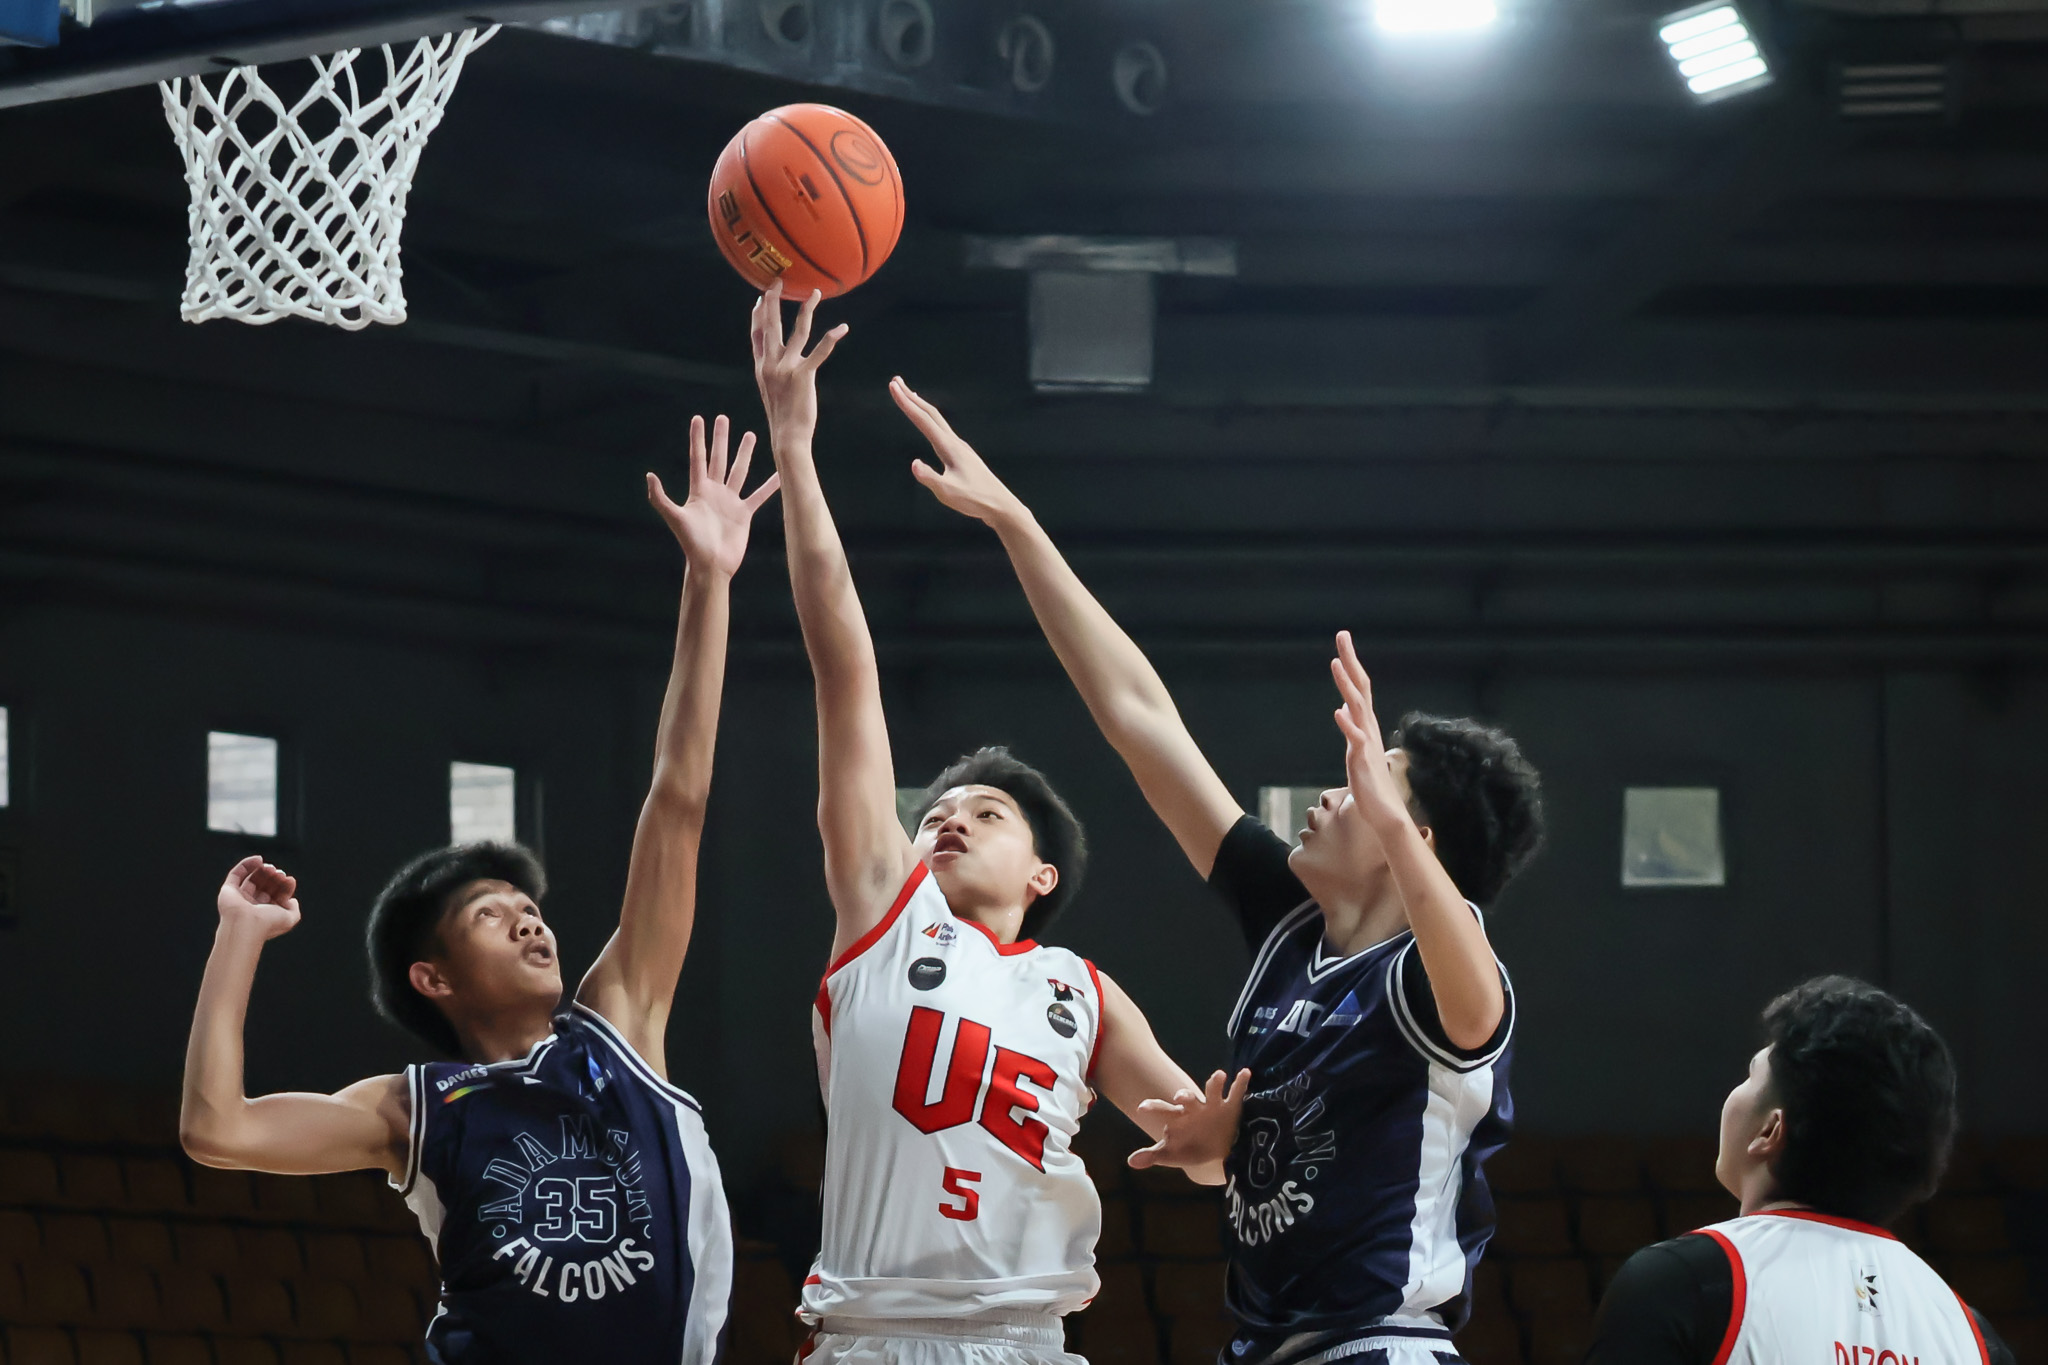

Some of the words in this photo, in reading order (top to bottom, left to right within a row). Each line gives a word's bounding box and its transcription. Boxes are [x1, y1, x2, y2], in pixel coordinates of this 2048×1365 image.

[435, 1065, 488, 1092] DAVIES
[891, 1005, 1059, 1174] UE
[533, 1175, 617, 1244] 35
[937, 1166, 982, 1221] 5
[492, 1237, 655, 1303] FALCONS
